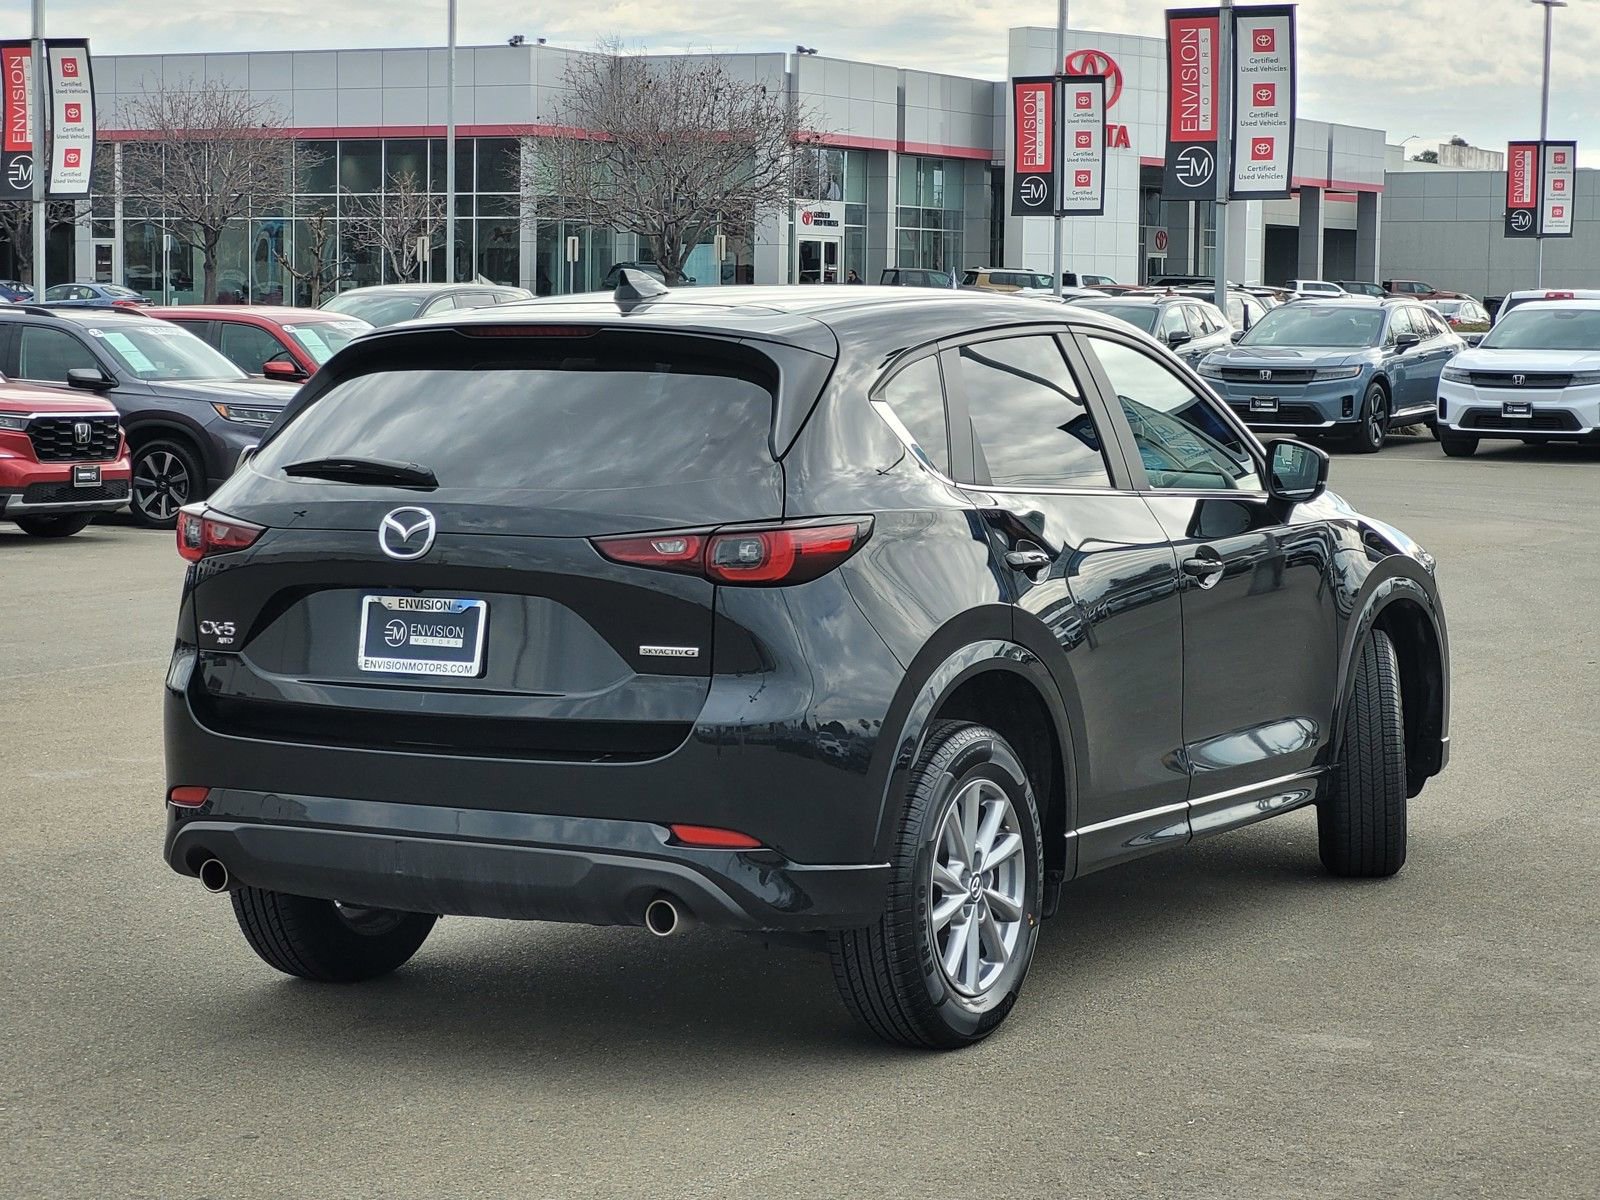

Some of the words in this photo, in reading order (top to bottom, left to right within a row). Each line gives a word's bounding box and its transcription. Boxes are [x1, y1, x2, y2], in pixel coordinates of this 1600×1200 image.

[1181, 28, 1198, 131] ENVISION
[10, 56, 26, 143] ENVISION
[1024, 90, 1036, 166] ENVISION
[1514, 150, 1524, 203] ENVISION
[398, 598, 451, 611] ENVISION
[200, 620, 236, 636] CX-5
[410, 623, 465, 639] ENVISION
[414, 638, 459, 646] MOTORS
[363, 659, 473, 674] ENVISIONMOTORS.COM
